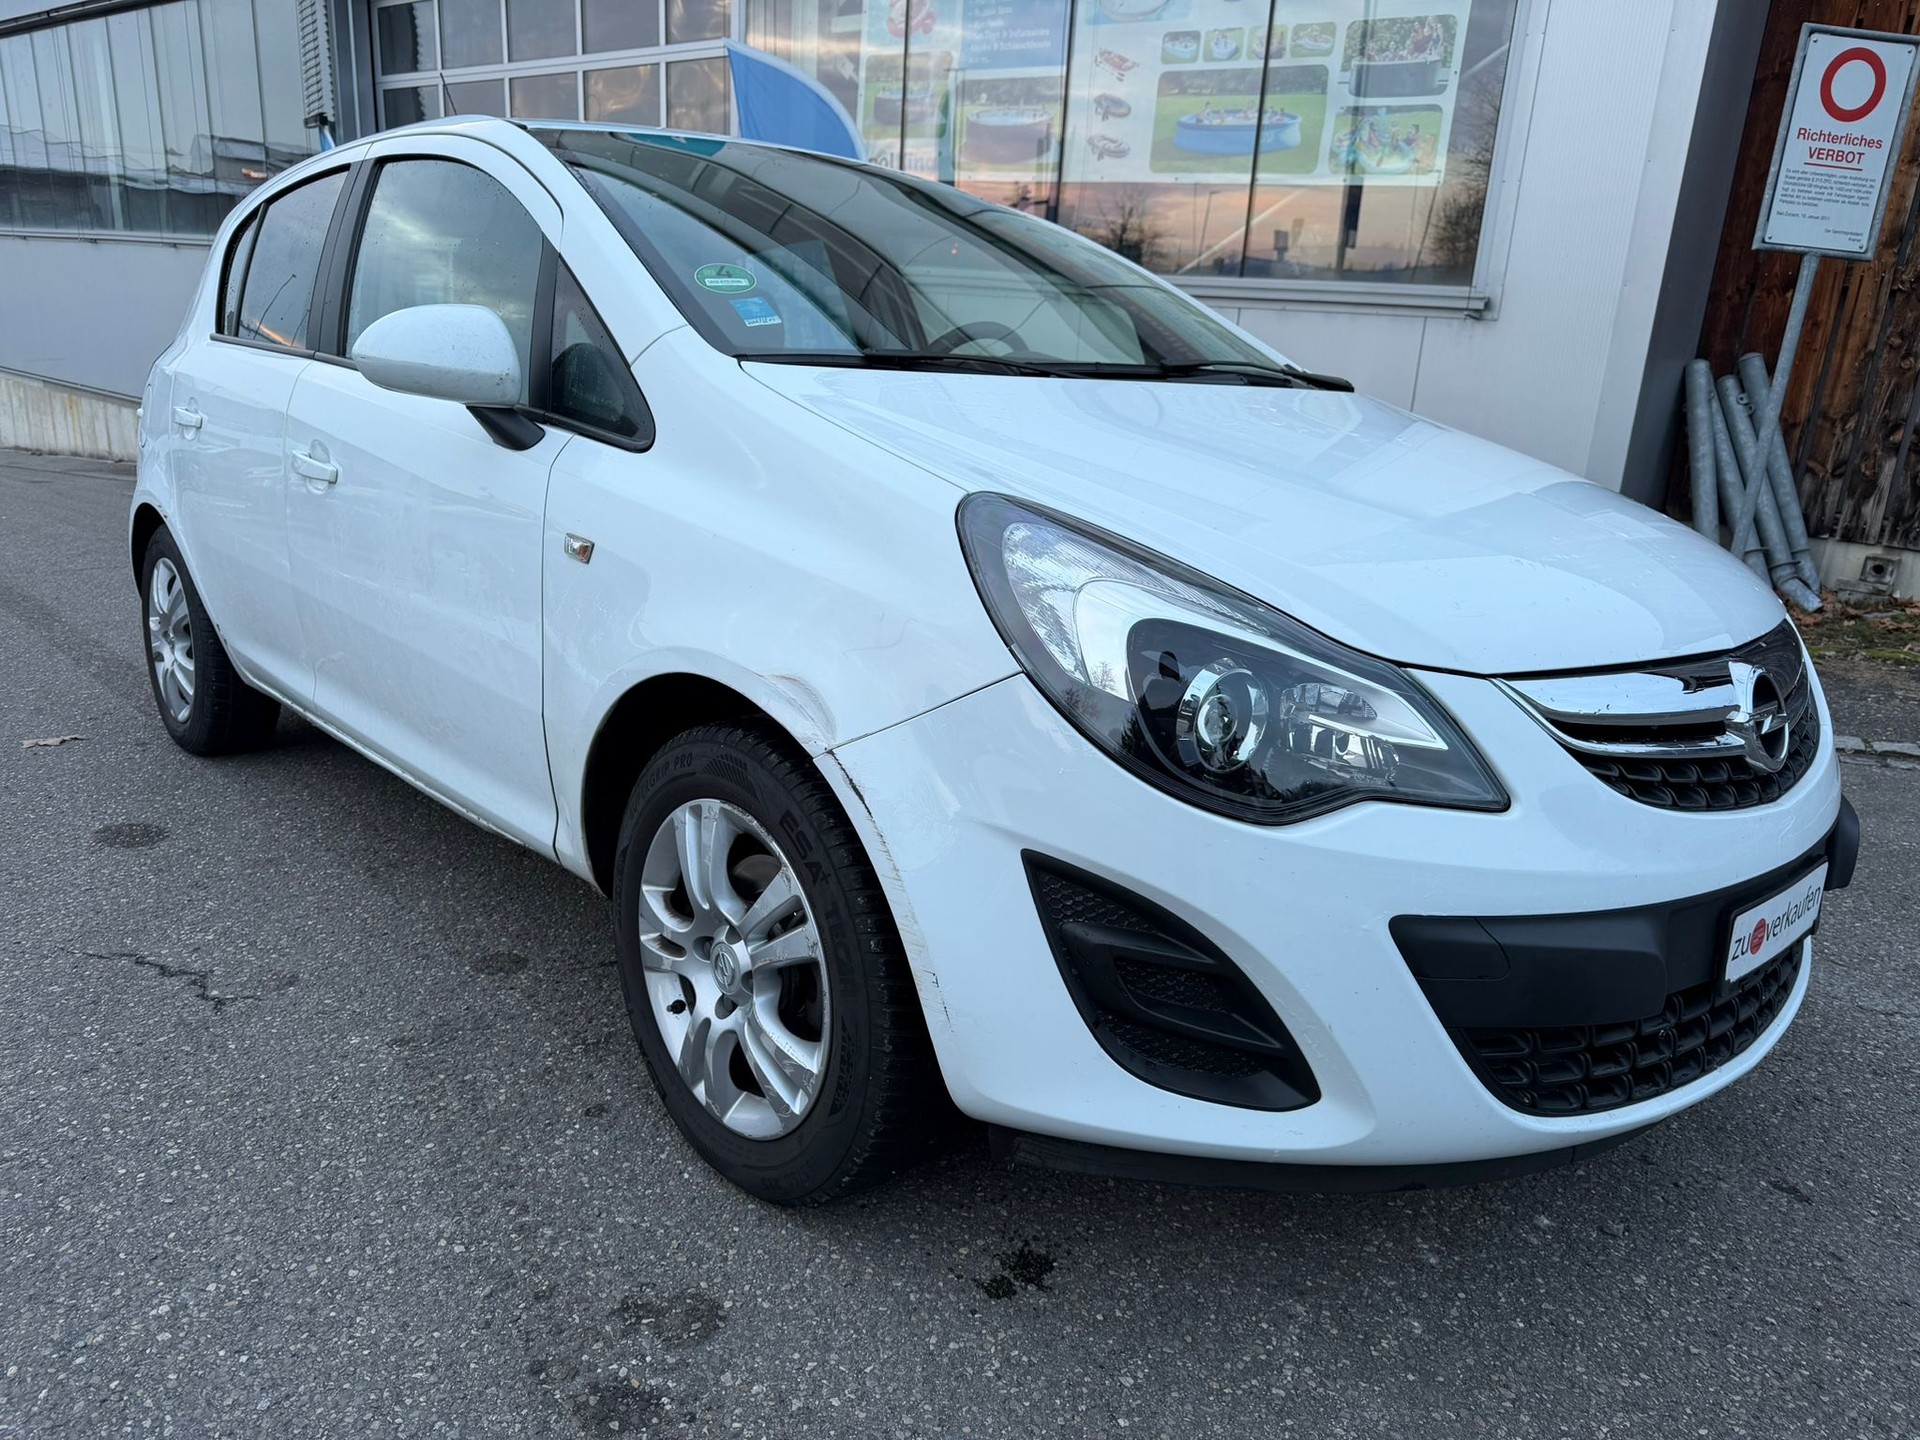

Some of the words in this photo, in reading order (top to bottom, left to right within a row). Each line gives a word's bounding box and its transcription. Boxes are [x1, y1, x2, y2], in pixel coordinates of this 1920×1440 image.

[1796, 127, 1883, 149] Richterliches
[1808, 146, 1866, 165] VERBOT
[673, 751, 694, 772] PRO
[1731, 932, 1751, 962] zu
[1766, 885, 1821, 942] verkaufen
